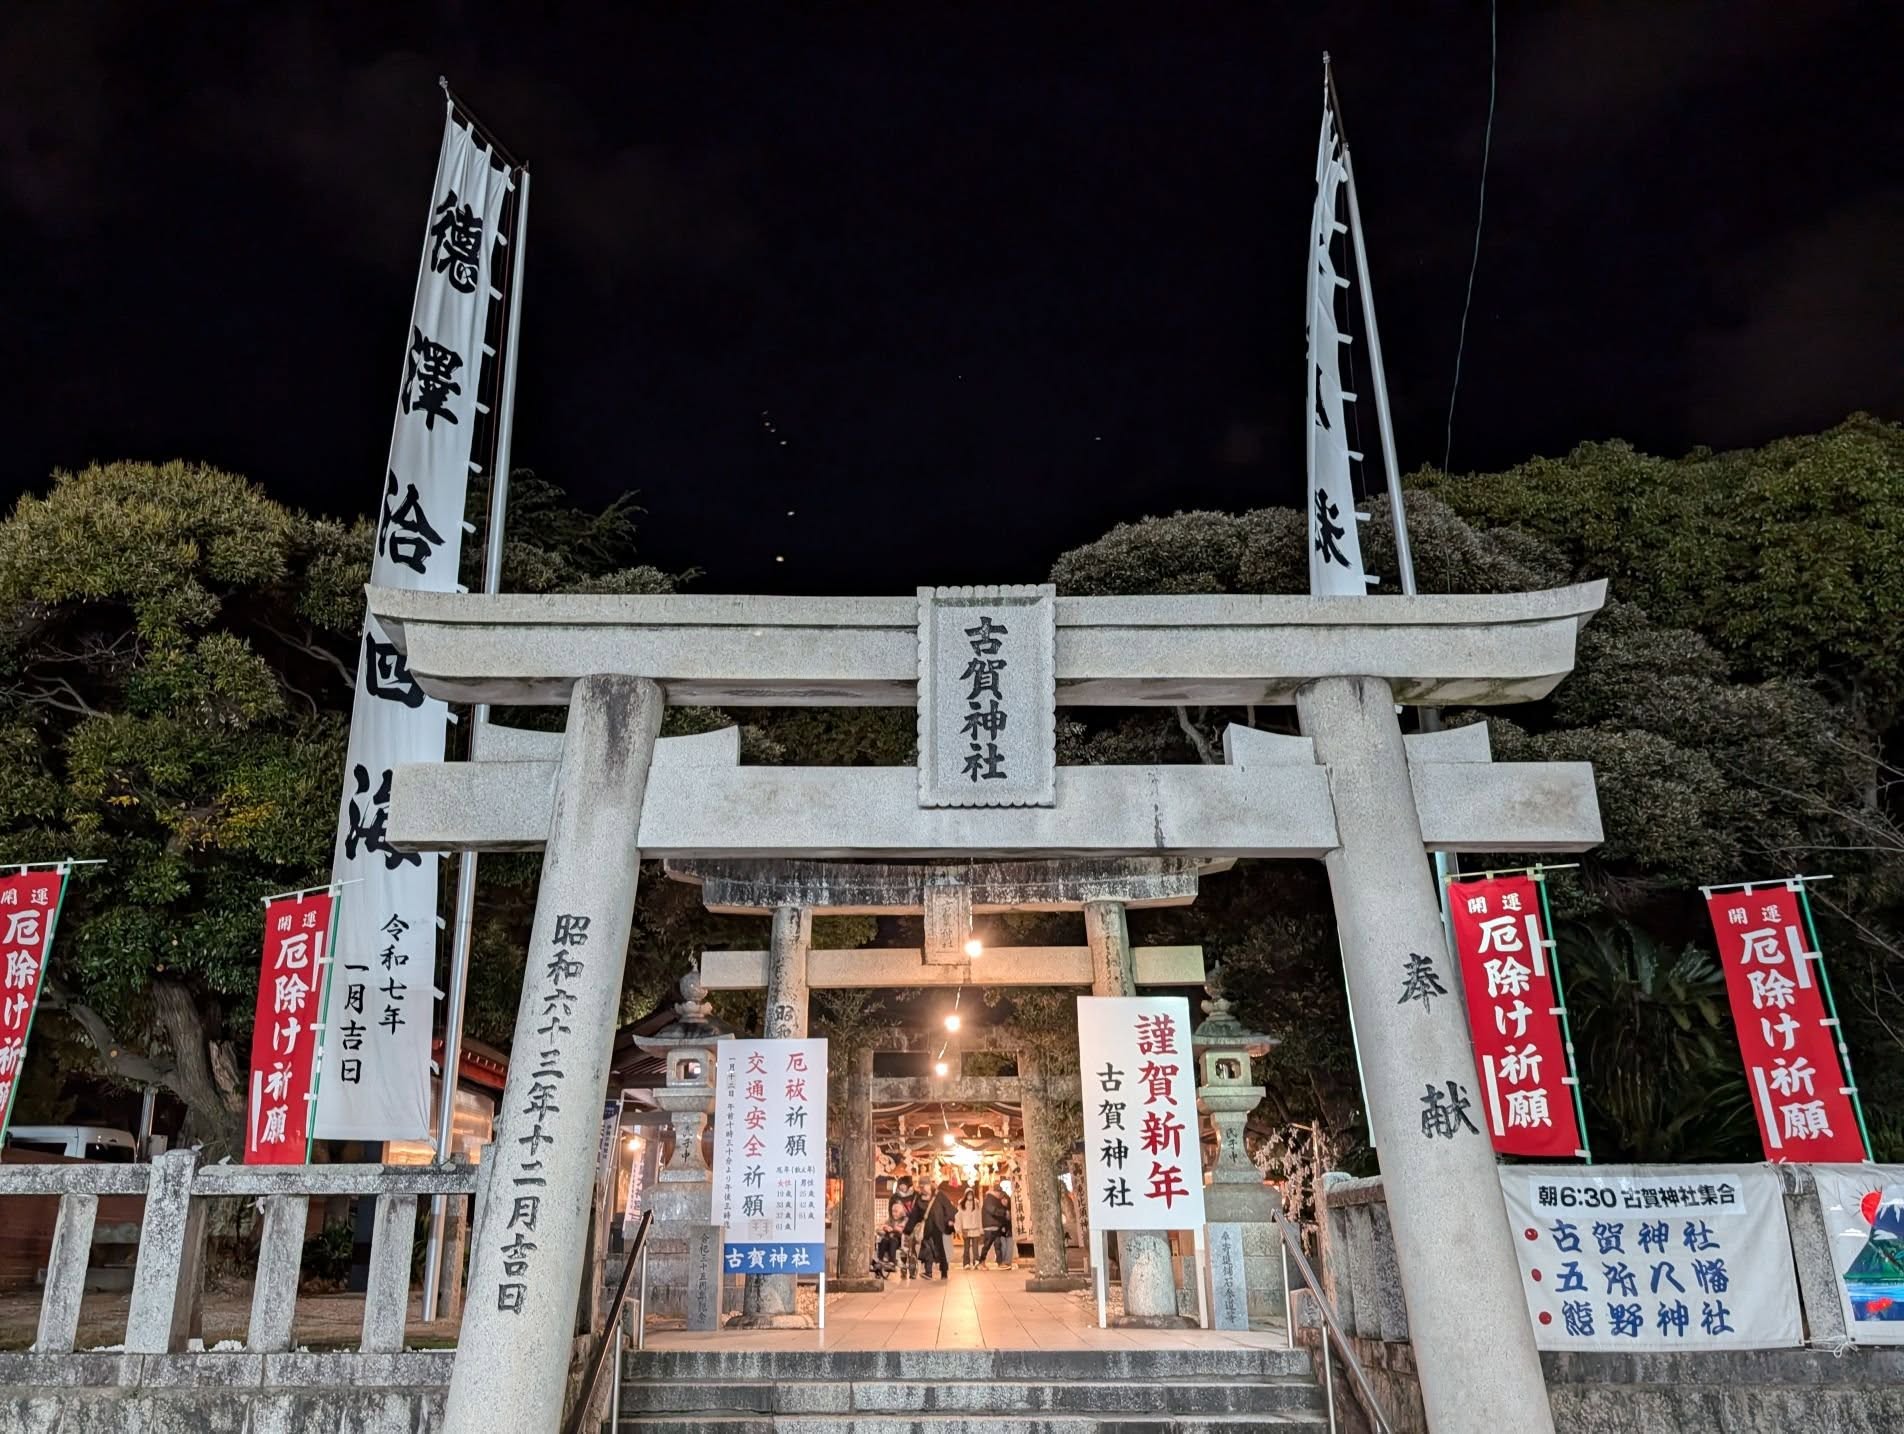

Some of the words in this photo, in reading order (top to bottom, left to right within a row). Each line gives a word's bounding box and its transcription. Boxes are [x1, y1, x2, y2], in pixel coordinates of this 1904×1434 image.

[959, 616, 1008, 783] 古賀神社
[277, 911, 317, 931] 開運
[1467, 893, 1522, 914] 開運
[1728, 905, 1782, 925] 開運
[340, 964, 369, 1085] 一月吉日
[378, 913, 410, 1035] 令和七年
[1478, 915, 1553, 1128] 厄除け祈願
[1740, 928, 1833, 1140] 厄除け祈願
[260, 932, 309, 1145] 厄除け祈願
[1397, 952, 1480, 1140] 奉献
[497, 913, 591, 1316] 昭和六十三年十二月吉日
[742, 1051, 768, 1217] 交通安全祈願
[784, 1052, 808, 1157] 厄祓祈願
[1097, 1062, 1134, 1208] 古賀神社
[1134, 1013, 1189, 1210] 謹賀新年
[1549, 1219, 1721, 1254] 古賀神社
[1624, 1183, 1735, 1209] 古賀神社集合
[725, 1247, 811, 1270] 古賀神社
[1555, 1258, 1729, 1297] 五所八幡
[1562, 1299, 1735, 1338] 熊野神社
